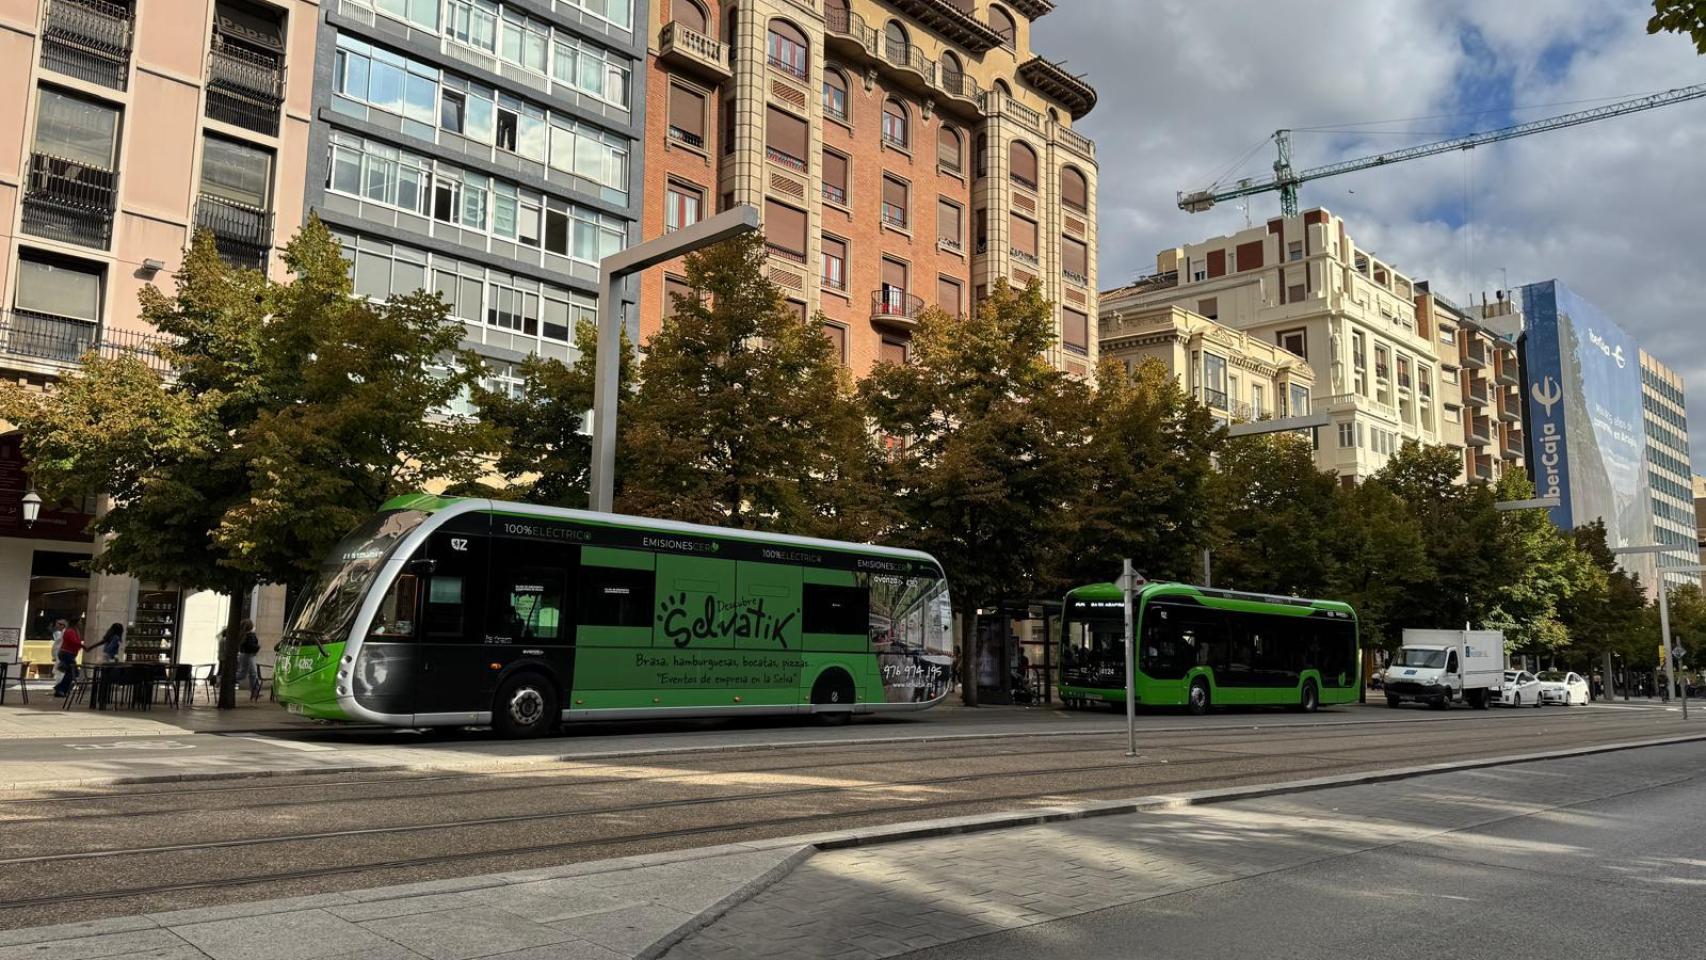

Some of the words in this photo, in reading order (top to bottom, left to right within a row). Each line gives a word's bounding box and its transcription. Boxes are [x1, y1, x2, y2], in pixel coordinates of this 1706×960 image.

[1540, 422, 1561, 501] berCaja
[700, 673, 711, 685] de
[751, 676, 761, 685] en
[884, 664, 901, 680] 976
[904, 664, 925, 680] 974
